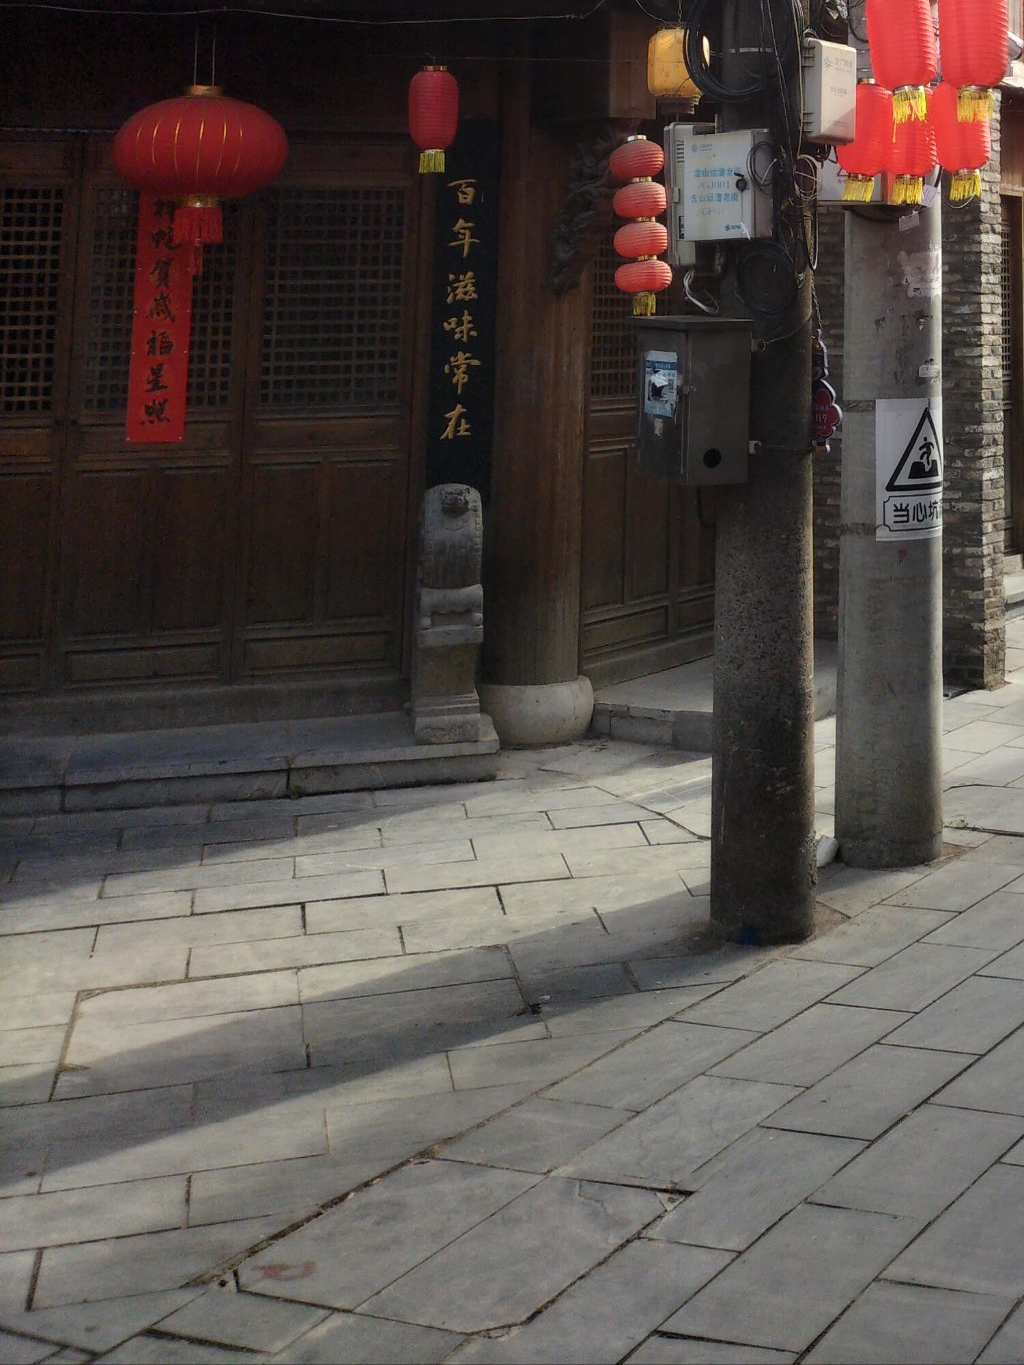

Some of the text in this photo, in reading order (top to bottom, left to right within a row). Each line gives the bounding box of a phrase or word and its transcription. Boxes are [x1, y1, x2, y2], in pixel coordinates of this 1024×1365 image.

[440, 179, 481, 441] 百年滋味常在
[893, 500, 942, 524] 当心坑
